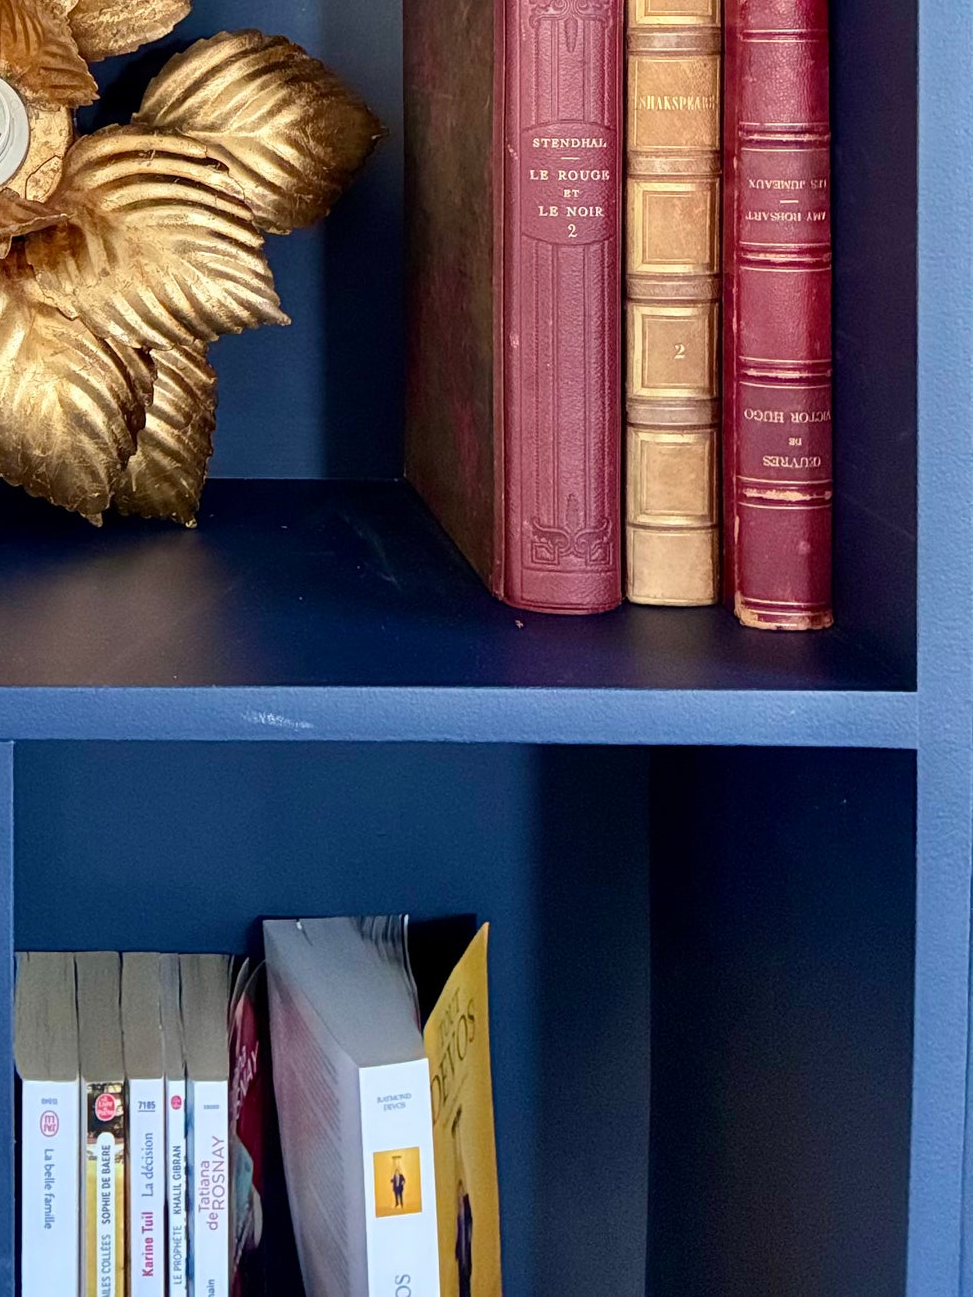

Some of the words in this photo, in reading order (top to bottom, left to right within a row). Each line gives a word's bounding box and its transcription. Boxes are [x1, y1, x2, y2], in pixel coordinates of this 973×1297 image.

[532, 138, 607, 148] STENDHAL
[530, 169, 548, 180] LE
[558, 170, 610, 181] ROUGE
[748, 179, 806, 190] JUMEAUX
[563, 189, 580, 198] ET
[538, 205, 559, 217] LE
[567, 206, 604, 217] NOIR
[567, 223, 578, 238] 2
[674, 343, 685, 360] 2
[744, 408, 785, 423] HUGO
[790, 410, 831, 423] VICTOR
[789, 437, 802, 446] DE
[43, 1148, 55, 1161] La
[101, 1144, 111, 1175] BAERE
[141, 1132, 154, 1180] décision
[172, 1145, 182, 1181] GIBRAN
[44, 1165, 56, 1191] belle
[211, 1135, 226, 1211] ROSNAY
[101, 1176, 111, 1189] DE
[141, 1184, 154, 1197] La
[198, 1160, 211, 1213] Tatiana
[172, 1183, 182, 1215] KHALIL
[44, 1192, 56, 1230] famille
[101, 1192, 111, 1225] SOPHIE
[141, 1211, 154, 1234] Tuil
[206, 1212, 219, 1231] de
[100, 1234, 112, 1274] COLLÉES
[142, 1237, 154, 1277] Karine
[173, 1275, 182, 1285] LE
